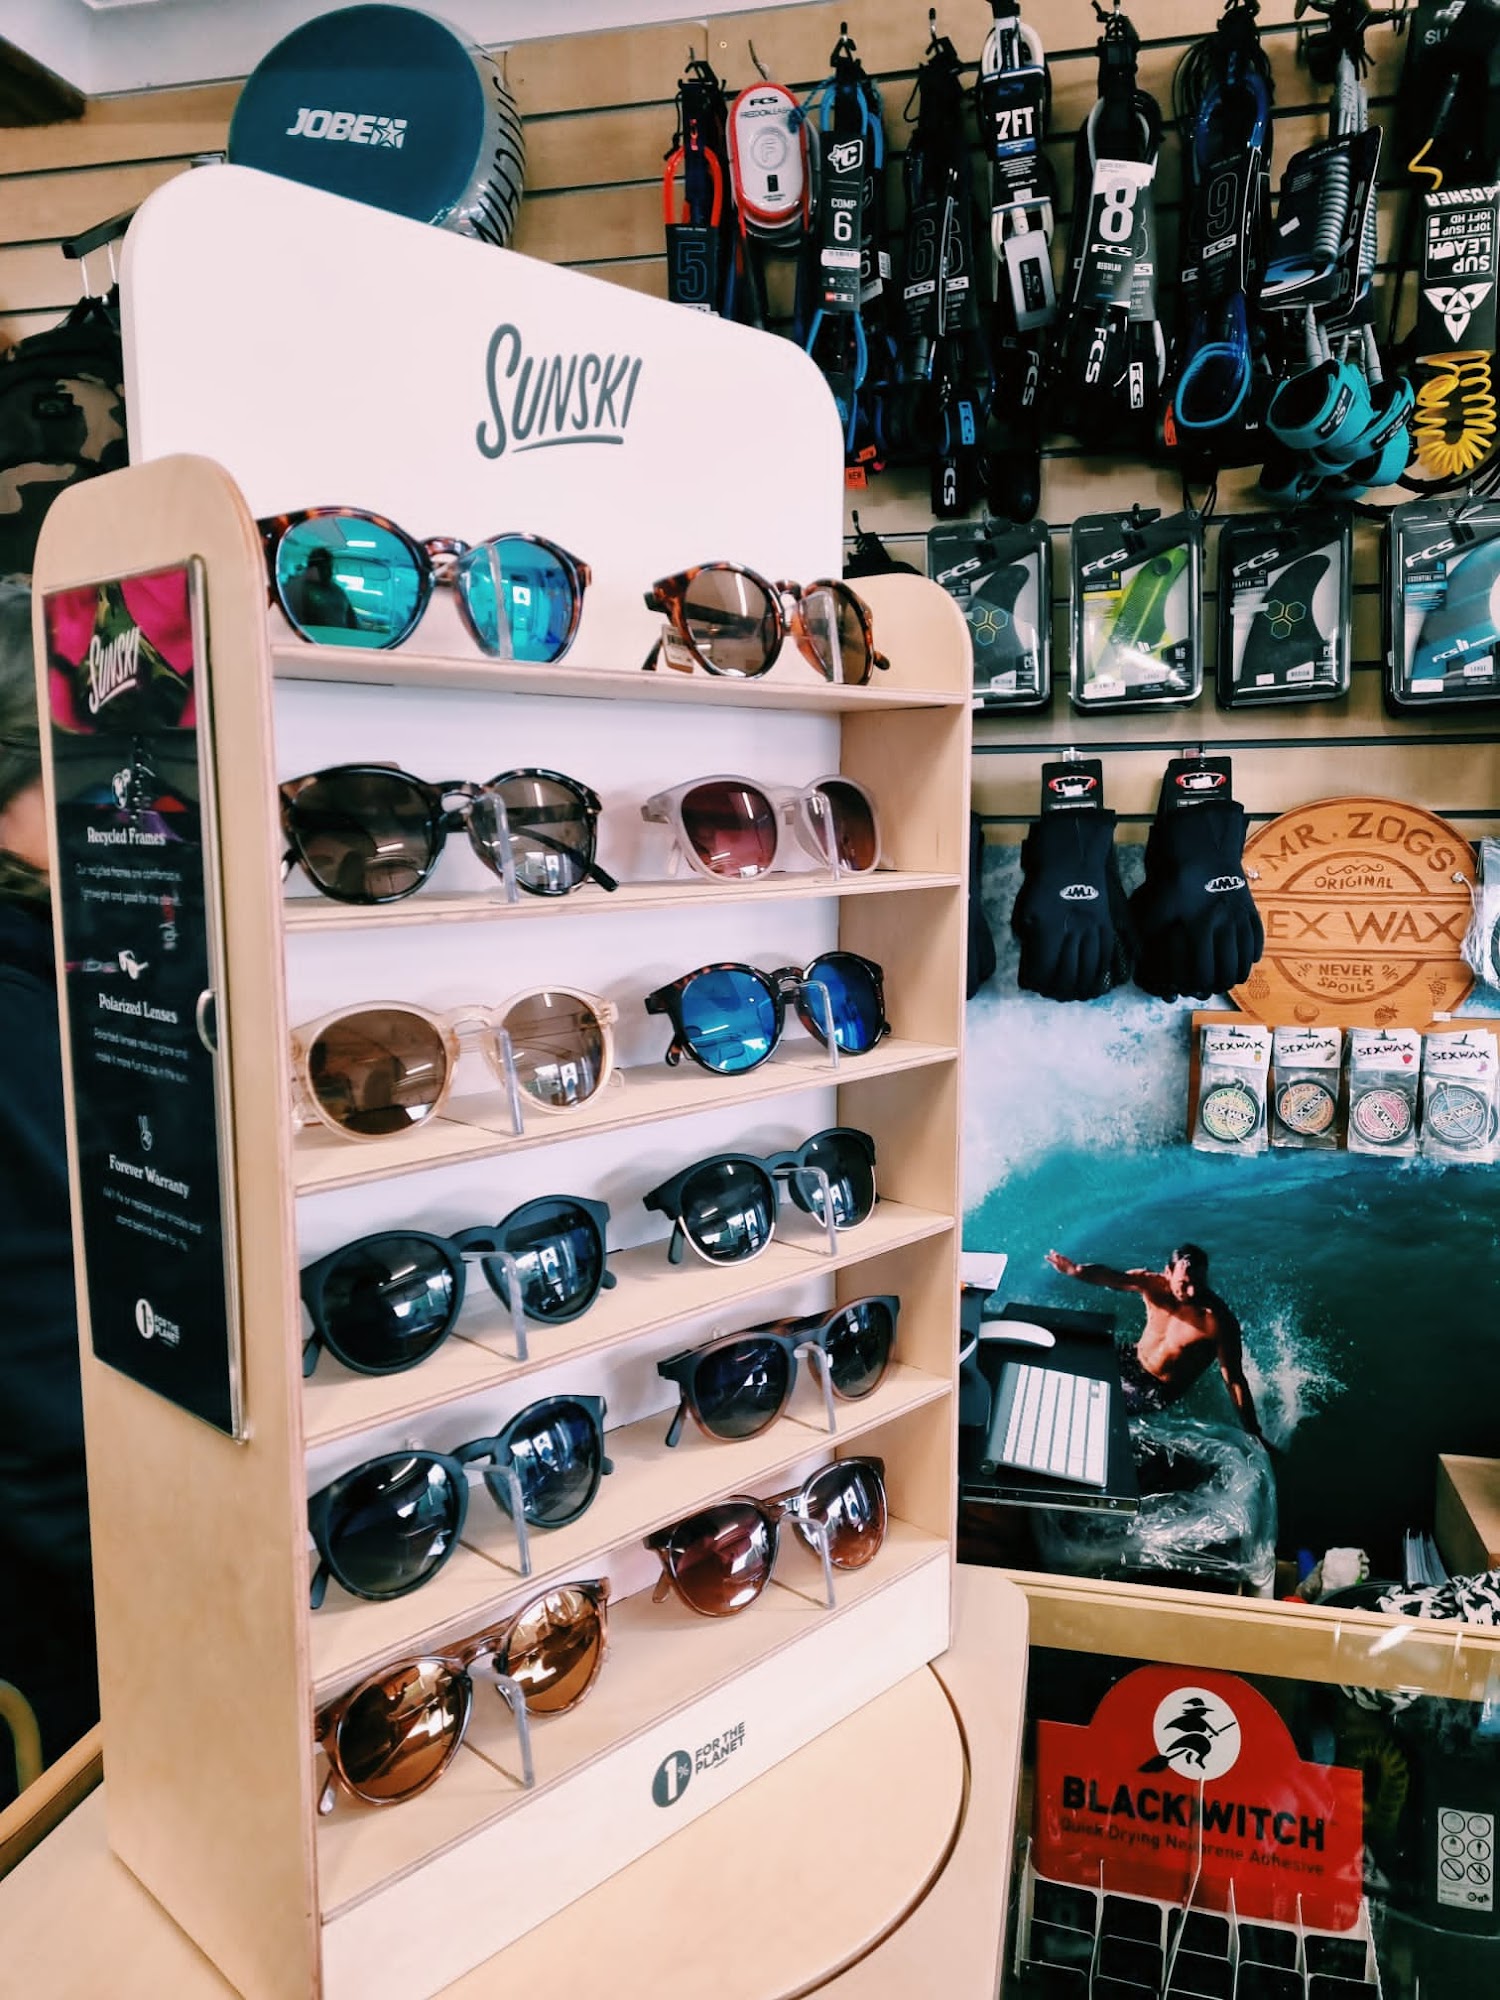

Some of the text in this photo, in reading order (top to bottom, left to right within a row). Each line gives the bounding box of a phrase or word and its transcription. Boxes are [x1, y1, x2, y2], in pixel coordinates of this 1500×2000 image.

[286, 108, 375, 144] JOBE
[996, 106, 1034, 140] 7FT
[831, 198, 857, 209] COMP
[1099, 177, 1138, 242] 8
[1207, 172, 1238, 239] 9
[1450, 211, 1491, 223] 10FT HD
[834, 211, 852, 241] 6
[1442, 221, 1491, 236] 10FT ISUP
[1091, 244, 1132, 258] FCS
[1428, 237, 1491, 260] LEAH
[1452, 254, 1490, 274] SUP
[677, 241, 708, 301] 5
[1085, 327, 1108, 384] FCS
[1022, 350, 1040, 406] FCS
[1131, 363, 1143, 407] FCS
[1081, 548, 1129, 577] FCS
[1232, 548, 1280, 577] FCS
[1405, 538, 1455, 568] FCS
[936, 557, 982, 584] FCS
[1408, 574, 1432, 582] ESSENTIAL
[87, 826, 167, 846] Recycled Frames
[1347, 812, 1455, 873] ZOGS
[1314, 874, 1394, 890] ORIGINAL
[1266, 910, 1465, 944] EX WAX
[1317, 976, 1375, 994] SPOILS
[1318, 963, 1374, 977] NEVER
[99, 992, 178, 1024] Polarized Lenses
[109, 1153, 190, 1199] Forever Warranty
[695, 1721, 745, 1762] FOR THE
[695, 1733, 745, 1775] PLANET
[1063, 1775, 1325, 1851] BLACK WITCH
[1060, 1817, 1104, 1836] Quick
[1108, 1825, 1160, 1850] Drying
